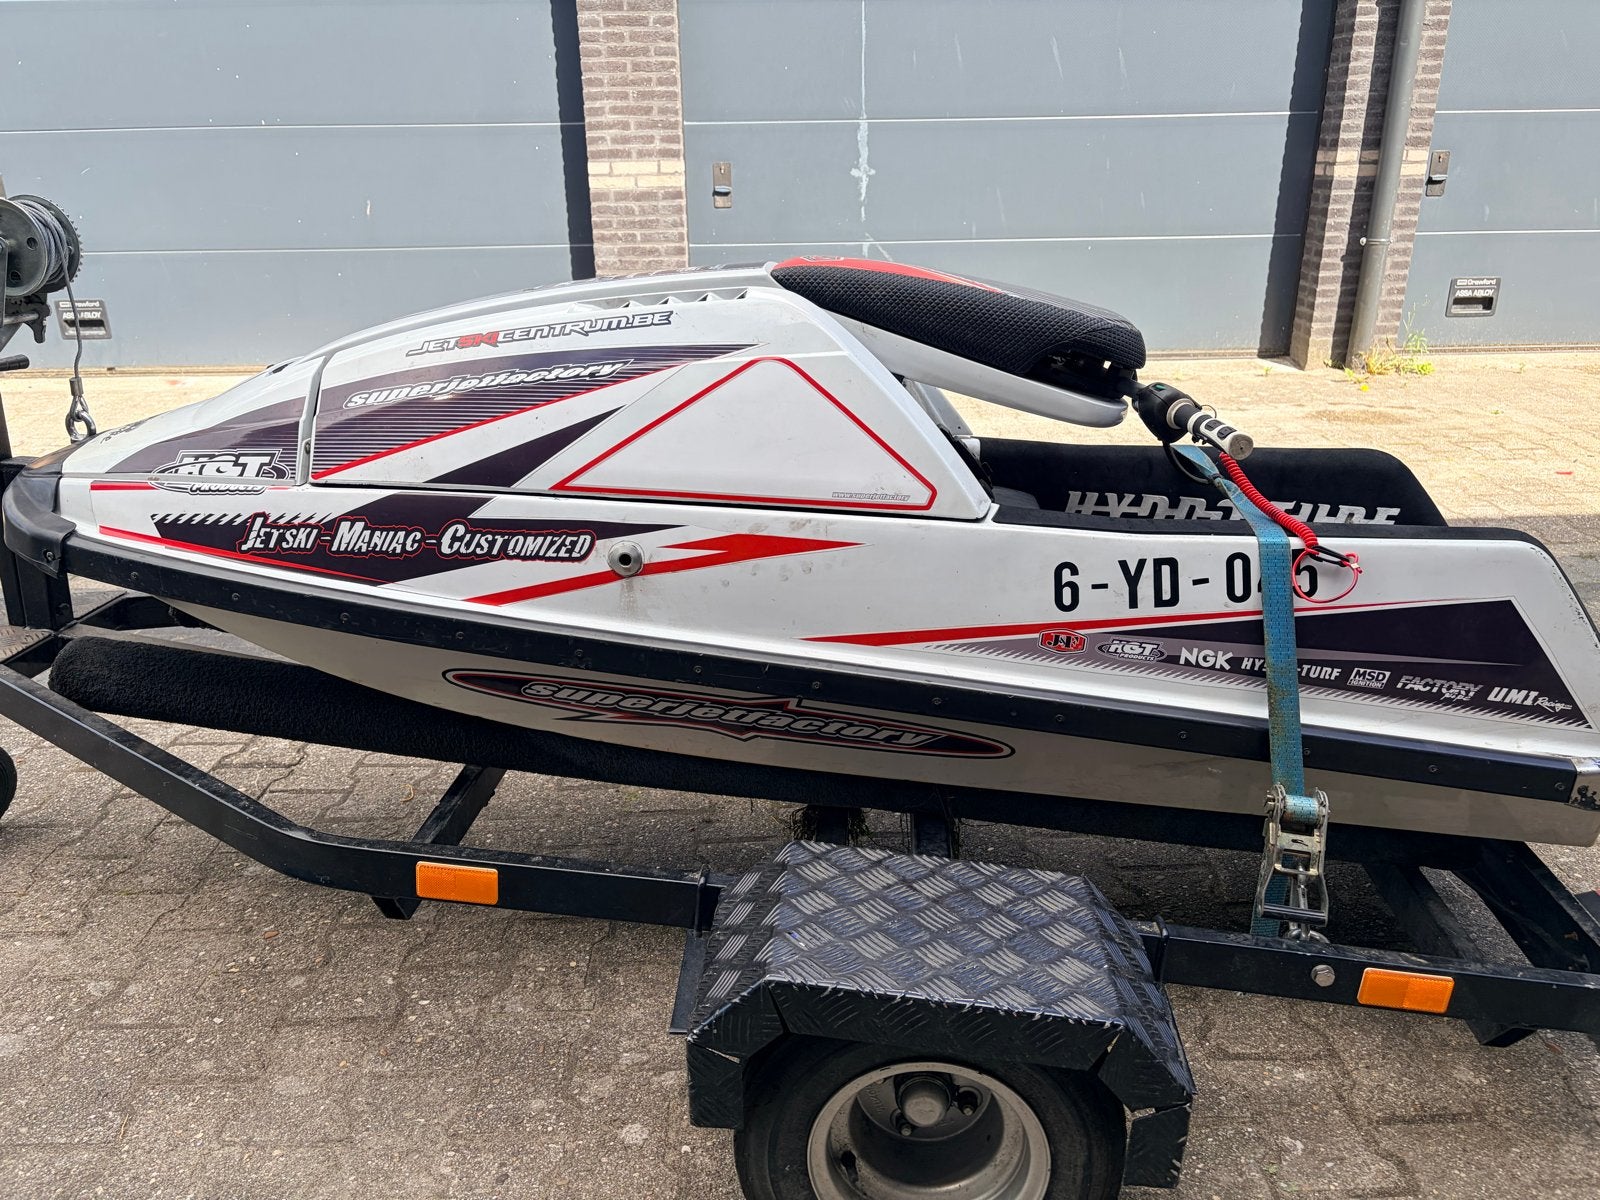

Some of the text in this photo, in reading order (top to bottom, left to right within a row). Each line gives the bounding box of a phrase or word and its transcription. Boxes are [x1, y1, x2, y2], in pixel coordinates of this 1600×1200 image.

[1455, 289, 1495, 297] ASSA ABLOY
[406, 311, 674, 356] JETSKICENTRUM.BE
[1179, 646, 1233, 671] NGK
[1350, 679, 1384, 689] IGNITION
[1353, 668, 1387, 682] MSD
[1396, 675, 1484, 697] FACTORY
[1486, 686, 1539, 706] UMI
[522, 681, 939, 747] superjetfactory
